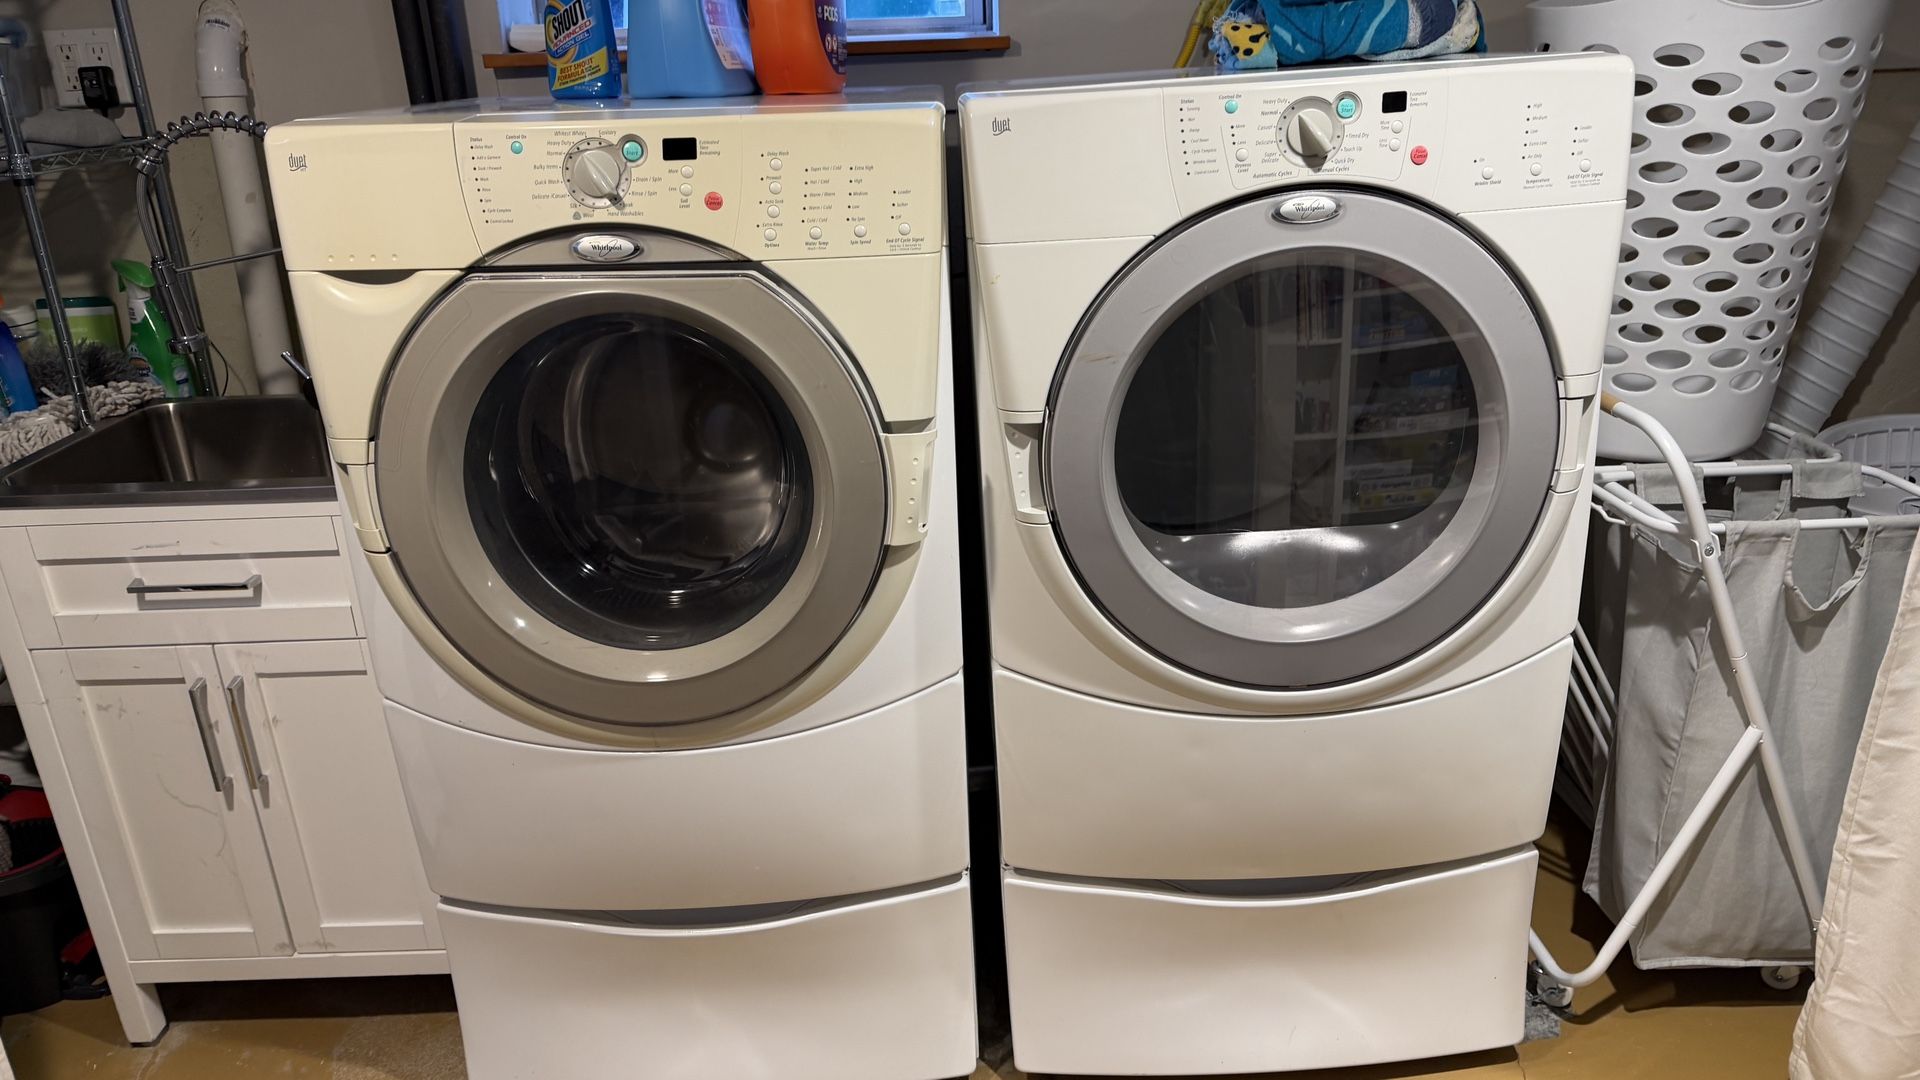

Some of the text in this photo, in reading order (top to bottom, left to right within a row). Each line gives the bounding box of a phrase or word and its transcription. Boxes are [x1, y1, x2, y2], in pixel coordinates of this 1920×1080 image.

[552, 0, 586, 39] SHOUT
[992, 116, 1011, 134] duet
[289, 153, 307, 169] duet
[1294, 204, 1326, 213] Whirlpool
[591, 243, 622, 252] Whirlpool
